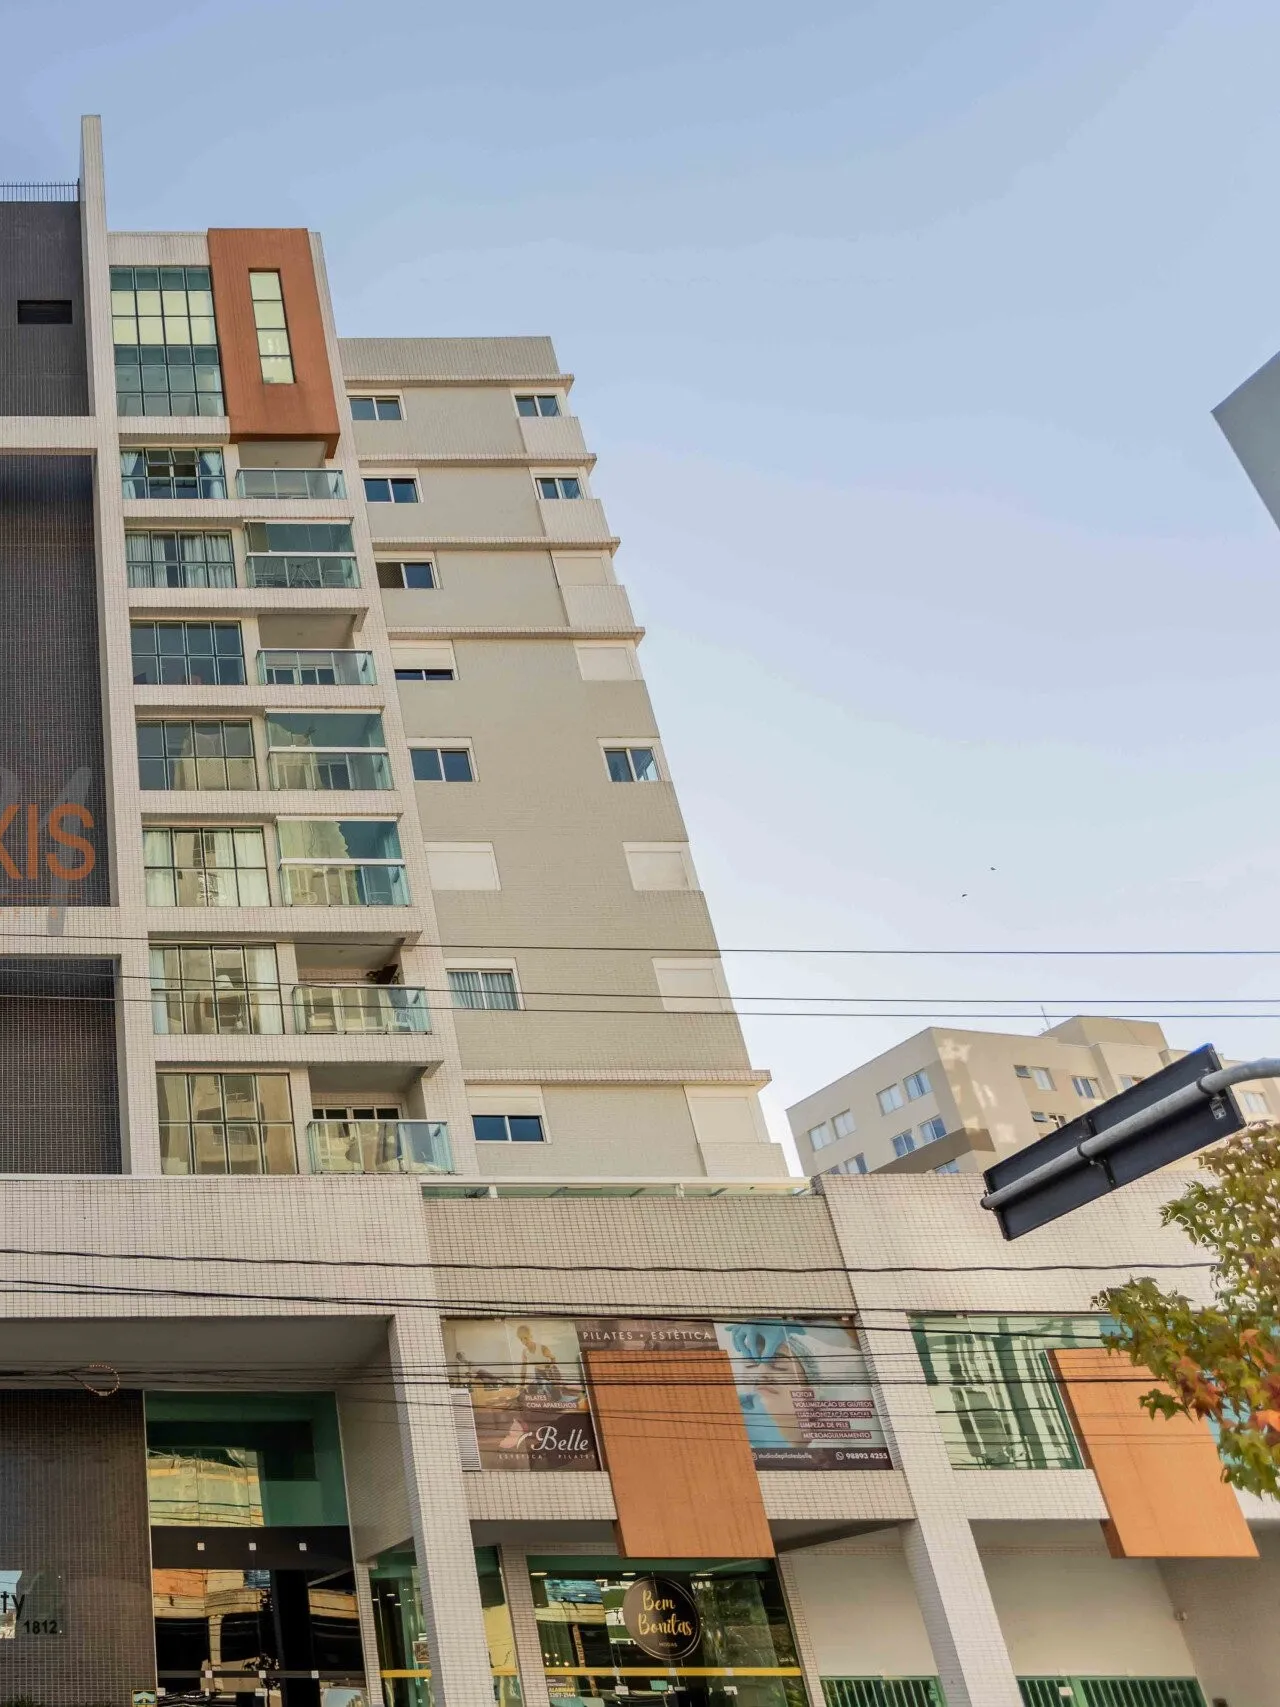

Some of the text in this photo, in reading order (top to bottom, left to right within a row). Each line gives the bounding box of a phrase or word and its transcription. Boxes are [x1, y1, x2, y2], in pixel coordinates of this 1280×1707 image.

[583, 1329, 712, 1340] PILATES ESTÉTICA
[531, 1426, 589, 1451] Belle
[870, 1452, 888, 1460] 4255
[642, 1589, 676, 1612] Bem
[23, 1620, 58, 1635] 1812
[638, 1613, 693, 1636] Bonitas
